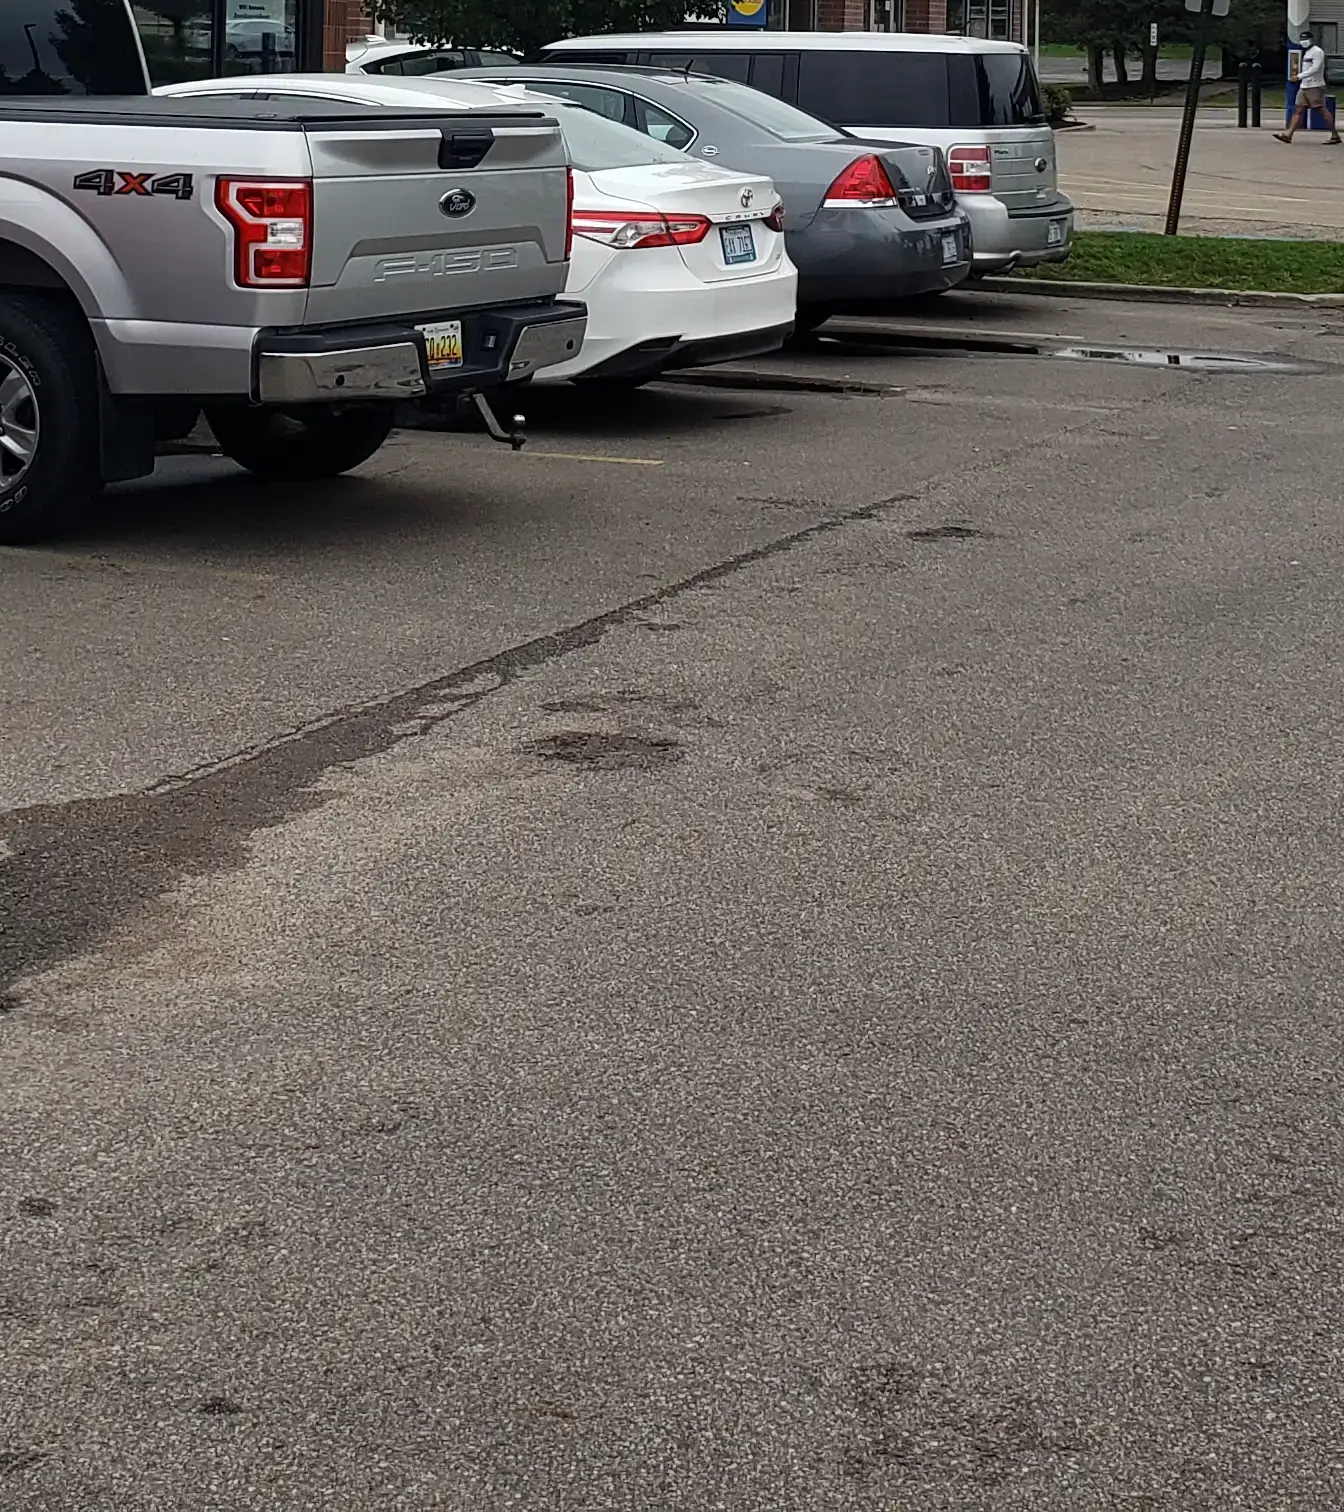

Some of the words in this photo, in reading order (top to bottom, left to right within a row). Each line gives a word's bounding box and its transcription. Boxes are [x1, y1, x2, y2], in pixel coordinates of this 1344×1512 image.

[449, 194, 471, 212] Ford
[725, 211, 765, 221] CAMRY
[373, 247, 519, 283] F-150
[440, 334, 458, 358] 232
